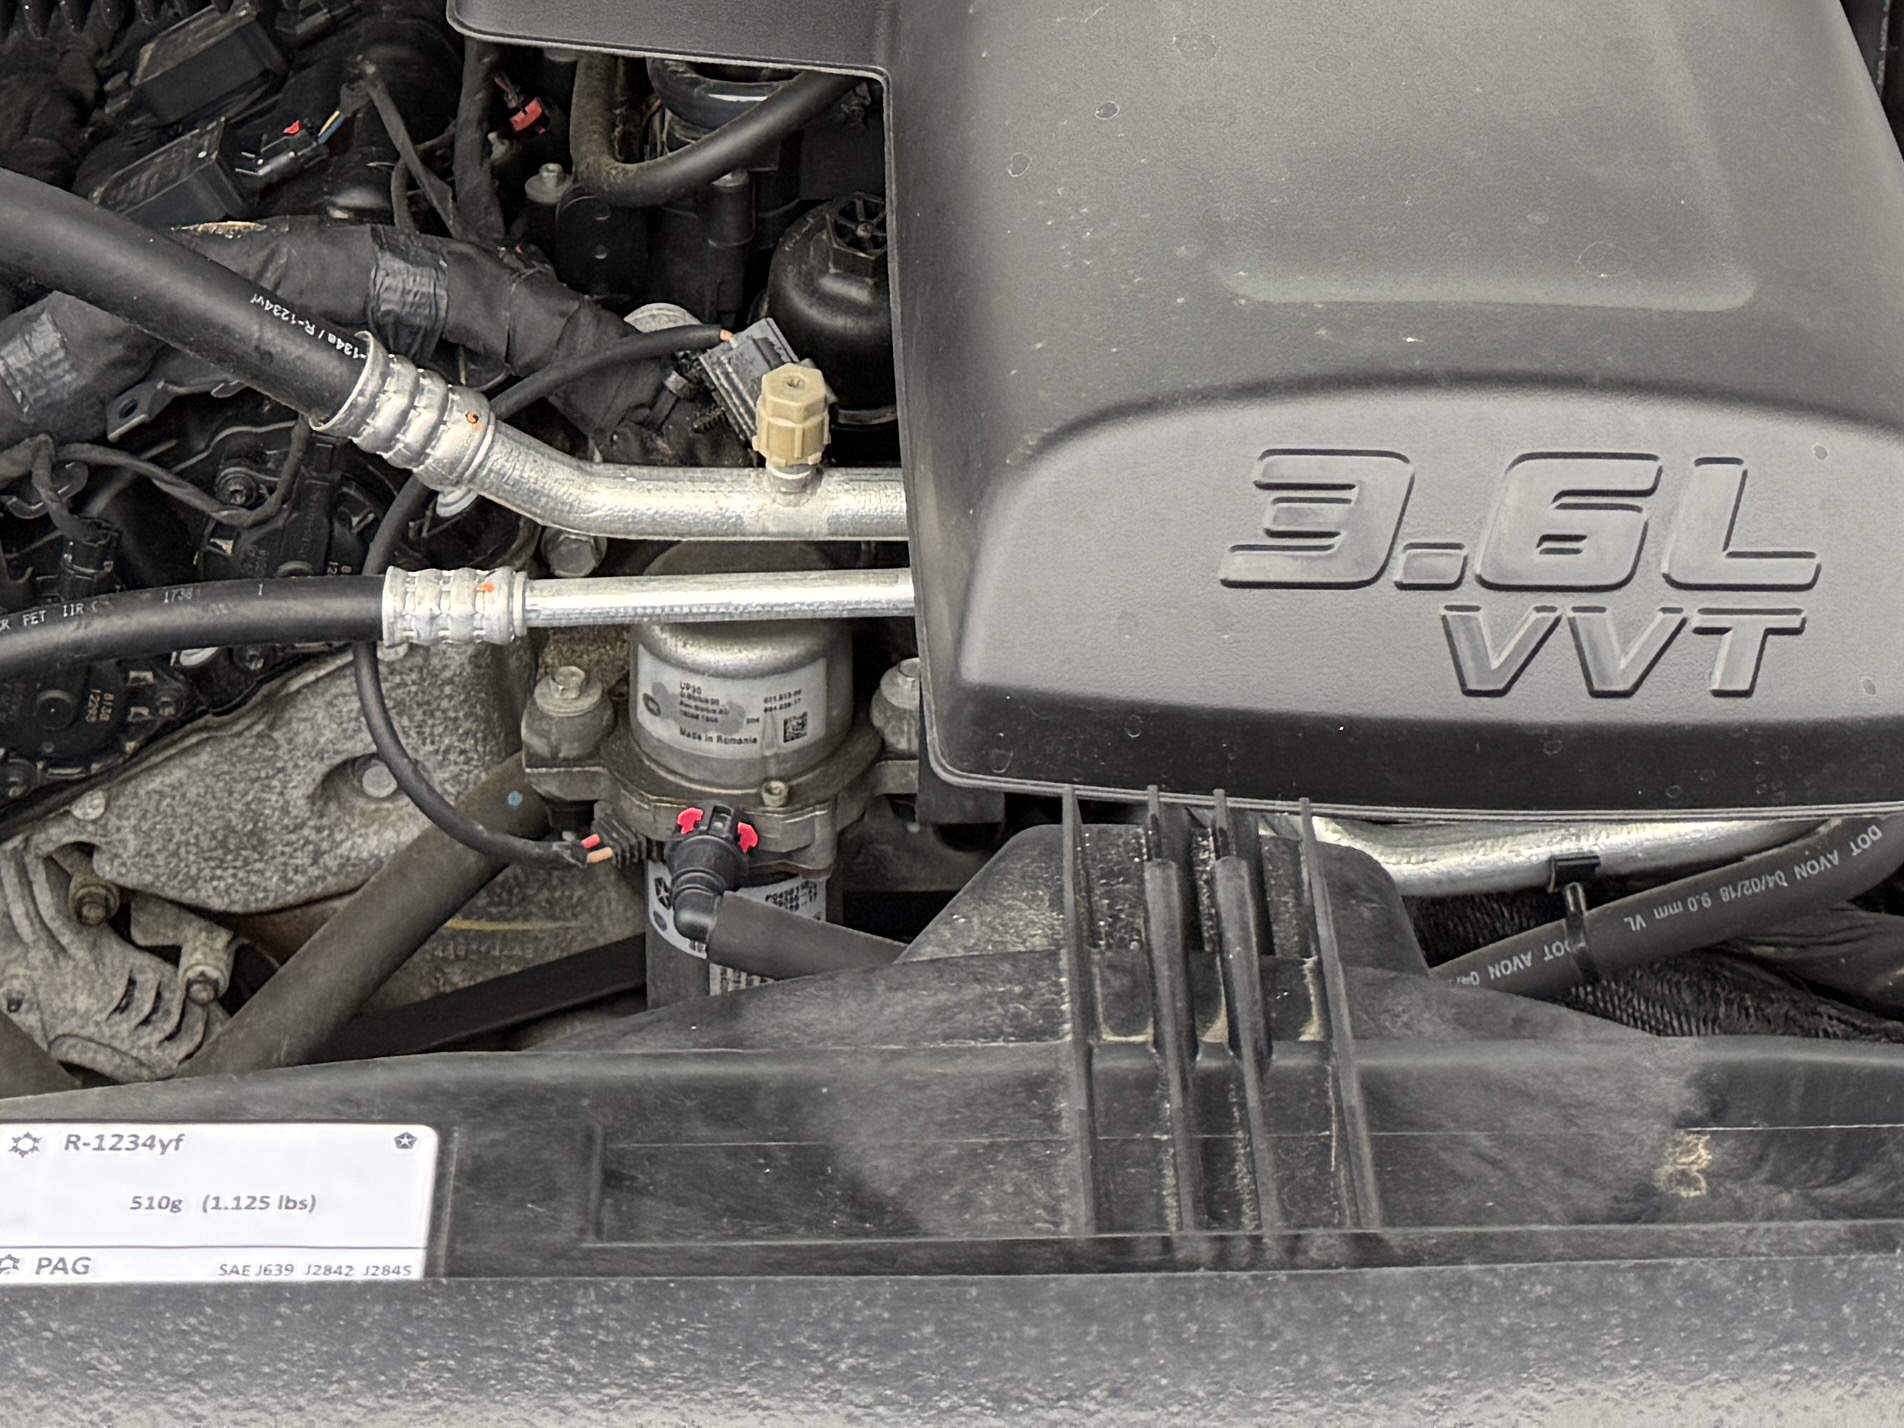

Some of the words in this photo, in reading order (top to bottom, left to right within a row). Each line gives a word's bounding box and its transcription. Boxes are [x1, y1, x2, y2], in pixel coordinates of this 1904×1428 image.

[1219, 447, 1822, 592] 3.6L
[21, 610, 48, 626] PET
[1439, 604, 1807, 698] VVT
[678, 726, 702, 741] Made
[704, 733, 713, 742] in
[716, 733, 757, 745] Romania
[1848, 823, 1883, 857] DOT
[1793, 848, 1841, 882] AVON
[1653, 897, 1687, 920] mm
[1690, 889, 1716, 913] 9.0
[1623, 912, 1648, 933] VL
[1486, 950, 1535, 980] AVON
[63, 1133, 186, 1155] R-1234yf
[129, 1195, 183, 1213] 510g
[201, 1194, 271, 1213] (1.125
[278, 1194, 317, 1213] lbs)
[34, 1256, 92, 1276] PAG
[218, 1264, 251, 1277] SAE
[255, 1264, 295, 1277] J639
[304, 1264, 354, 1277] J2842
[362, 1264, 413, 1277] J2845
